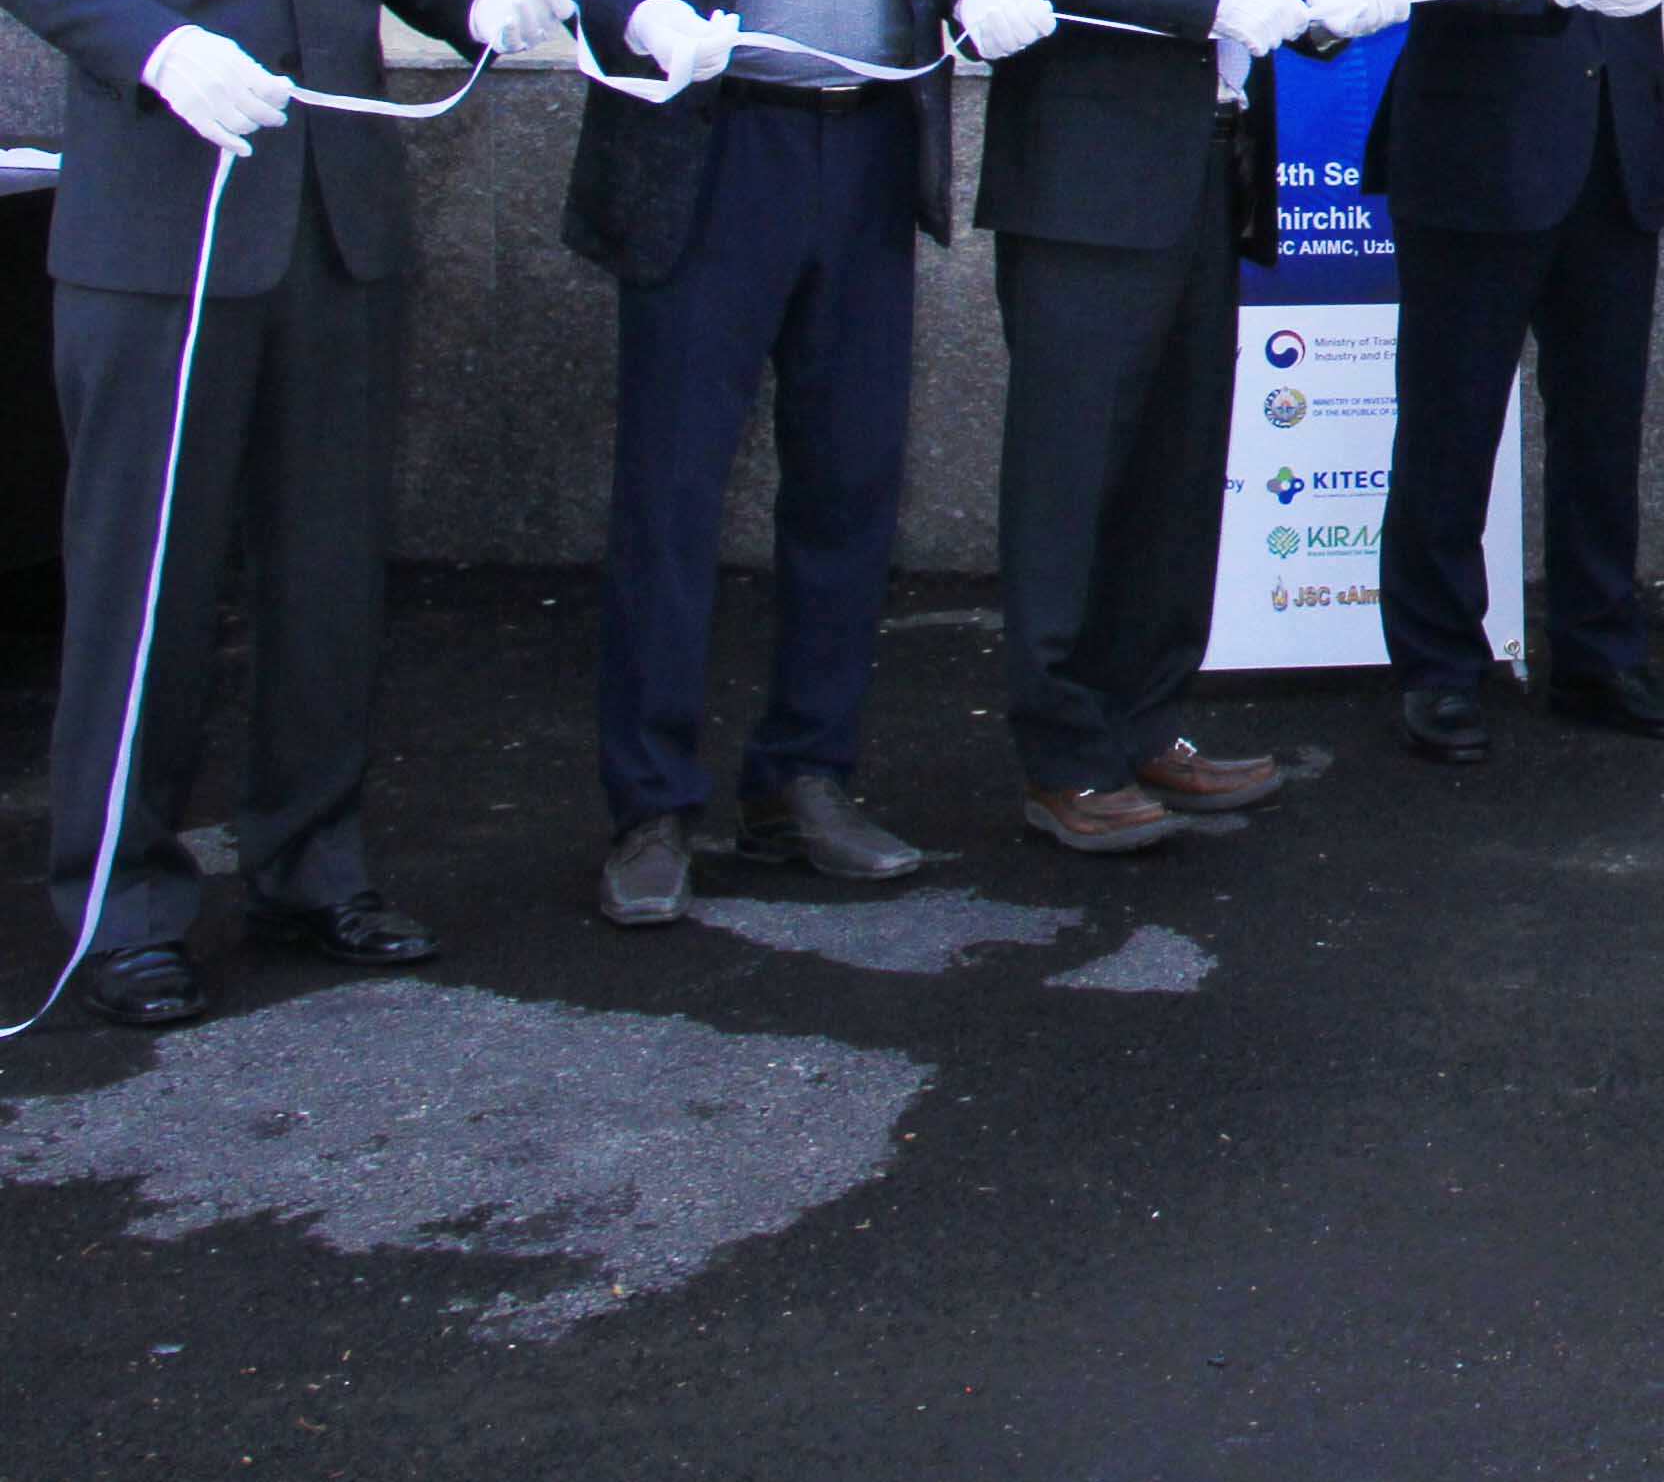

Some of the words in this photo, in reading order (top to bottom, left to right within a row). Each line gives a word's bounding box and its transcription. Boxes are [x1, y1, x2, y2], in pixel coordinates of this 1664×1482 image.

[1323, 161, 1361, 186] Se
[1277, 205, 1372, 230] hirchik
[1299, 239, 1359, 257] AMMC,
[1363, 239, 1396, 254] Uzb
[1314, 337, 1356, 349] Ministry
[1359, 336, 1371, 347] of
[1314, 351, 1357, 362] Industry
[1360, 351, 1381, 361] and
[1293, 585, 1331, 607] JSC
